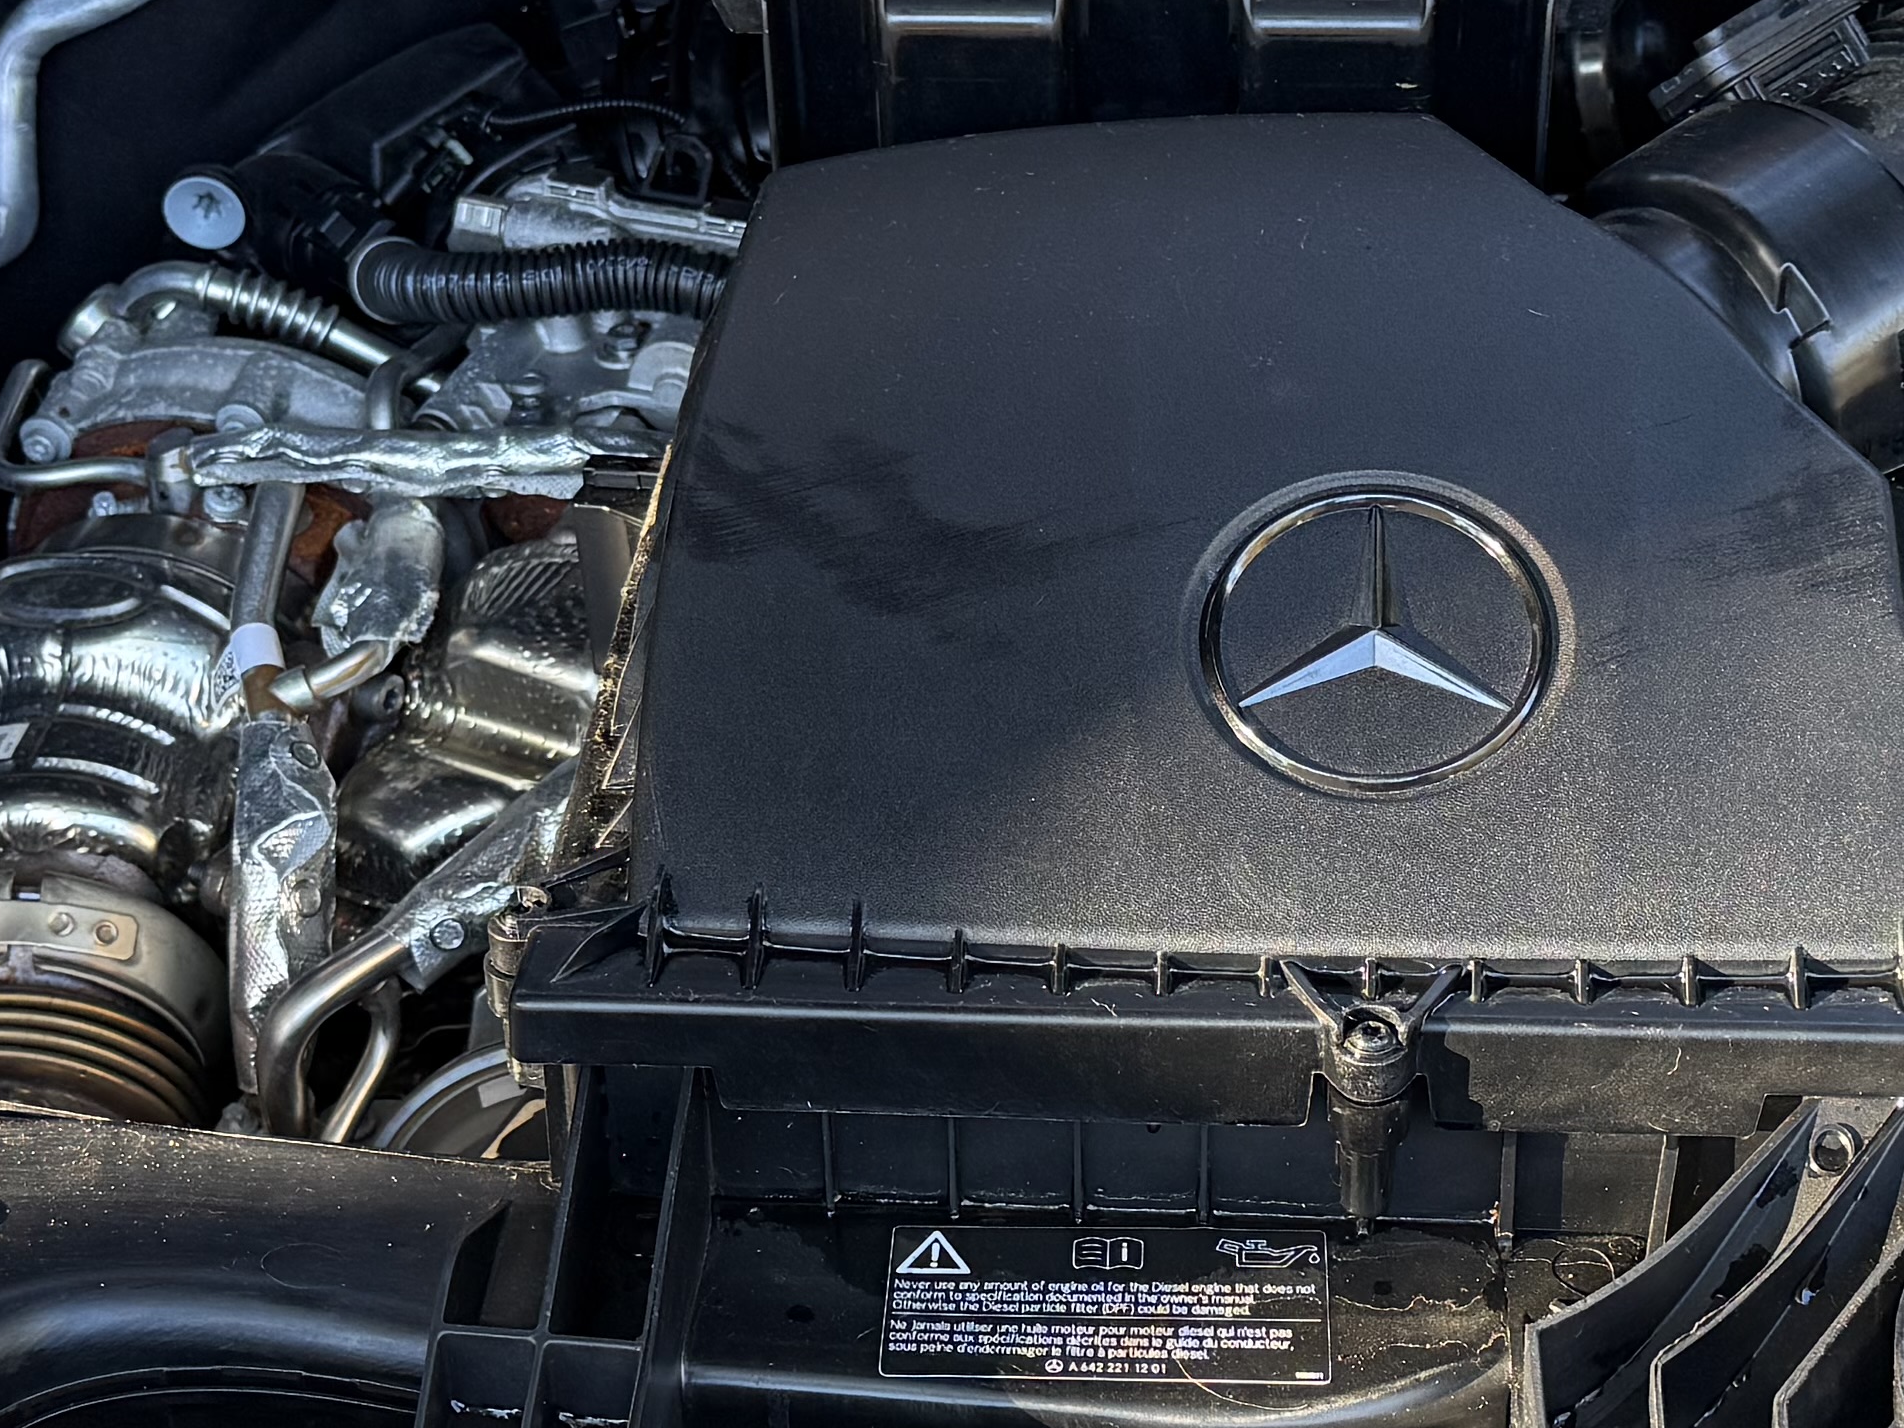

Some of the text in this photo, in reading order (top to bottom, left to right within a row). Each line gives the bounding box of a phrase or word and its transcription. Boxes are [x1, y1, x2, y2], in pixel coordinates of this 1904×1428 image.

[893, 1278, 931, 1289] Never
[1030, 1280, 1044, 1291] of
[1047, 1280, 1088, 1293] engine
[1106, 1281, 1125, 1292] for
[1128, 1281, 1150, 1293] the
[1151, 1282, 1189, 1293] Diesel
[1190, 1282, 1232, 1296] engine
[1234, 1283, 1258, 1294] that
[1262, 1283, 1293, 1295] does
[1295, 1284, 1316, 1295] not
[893, 1288, 946, 1300] conform
[1067, 1361, 1166, 1374] A 642 221 12 01
